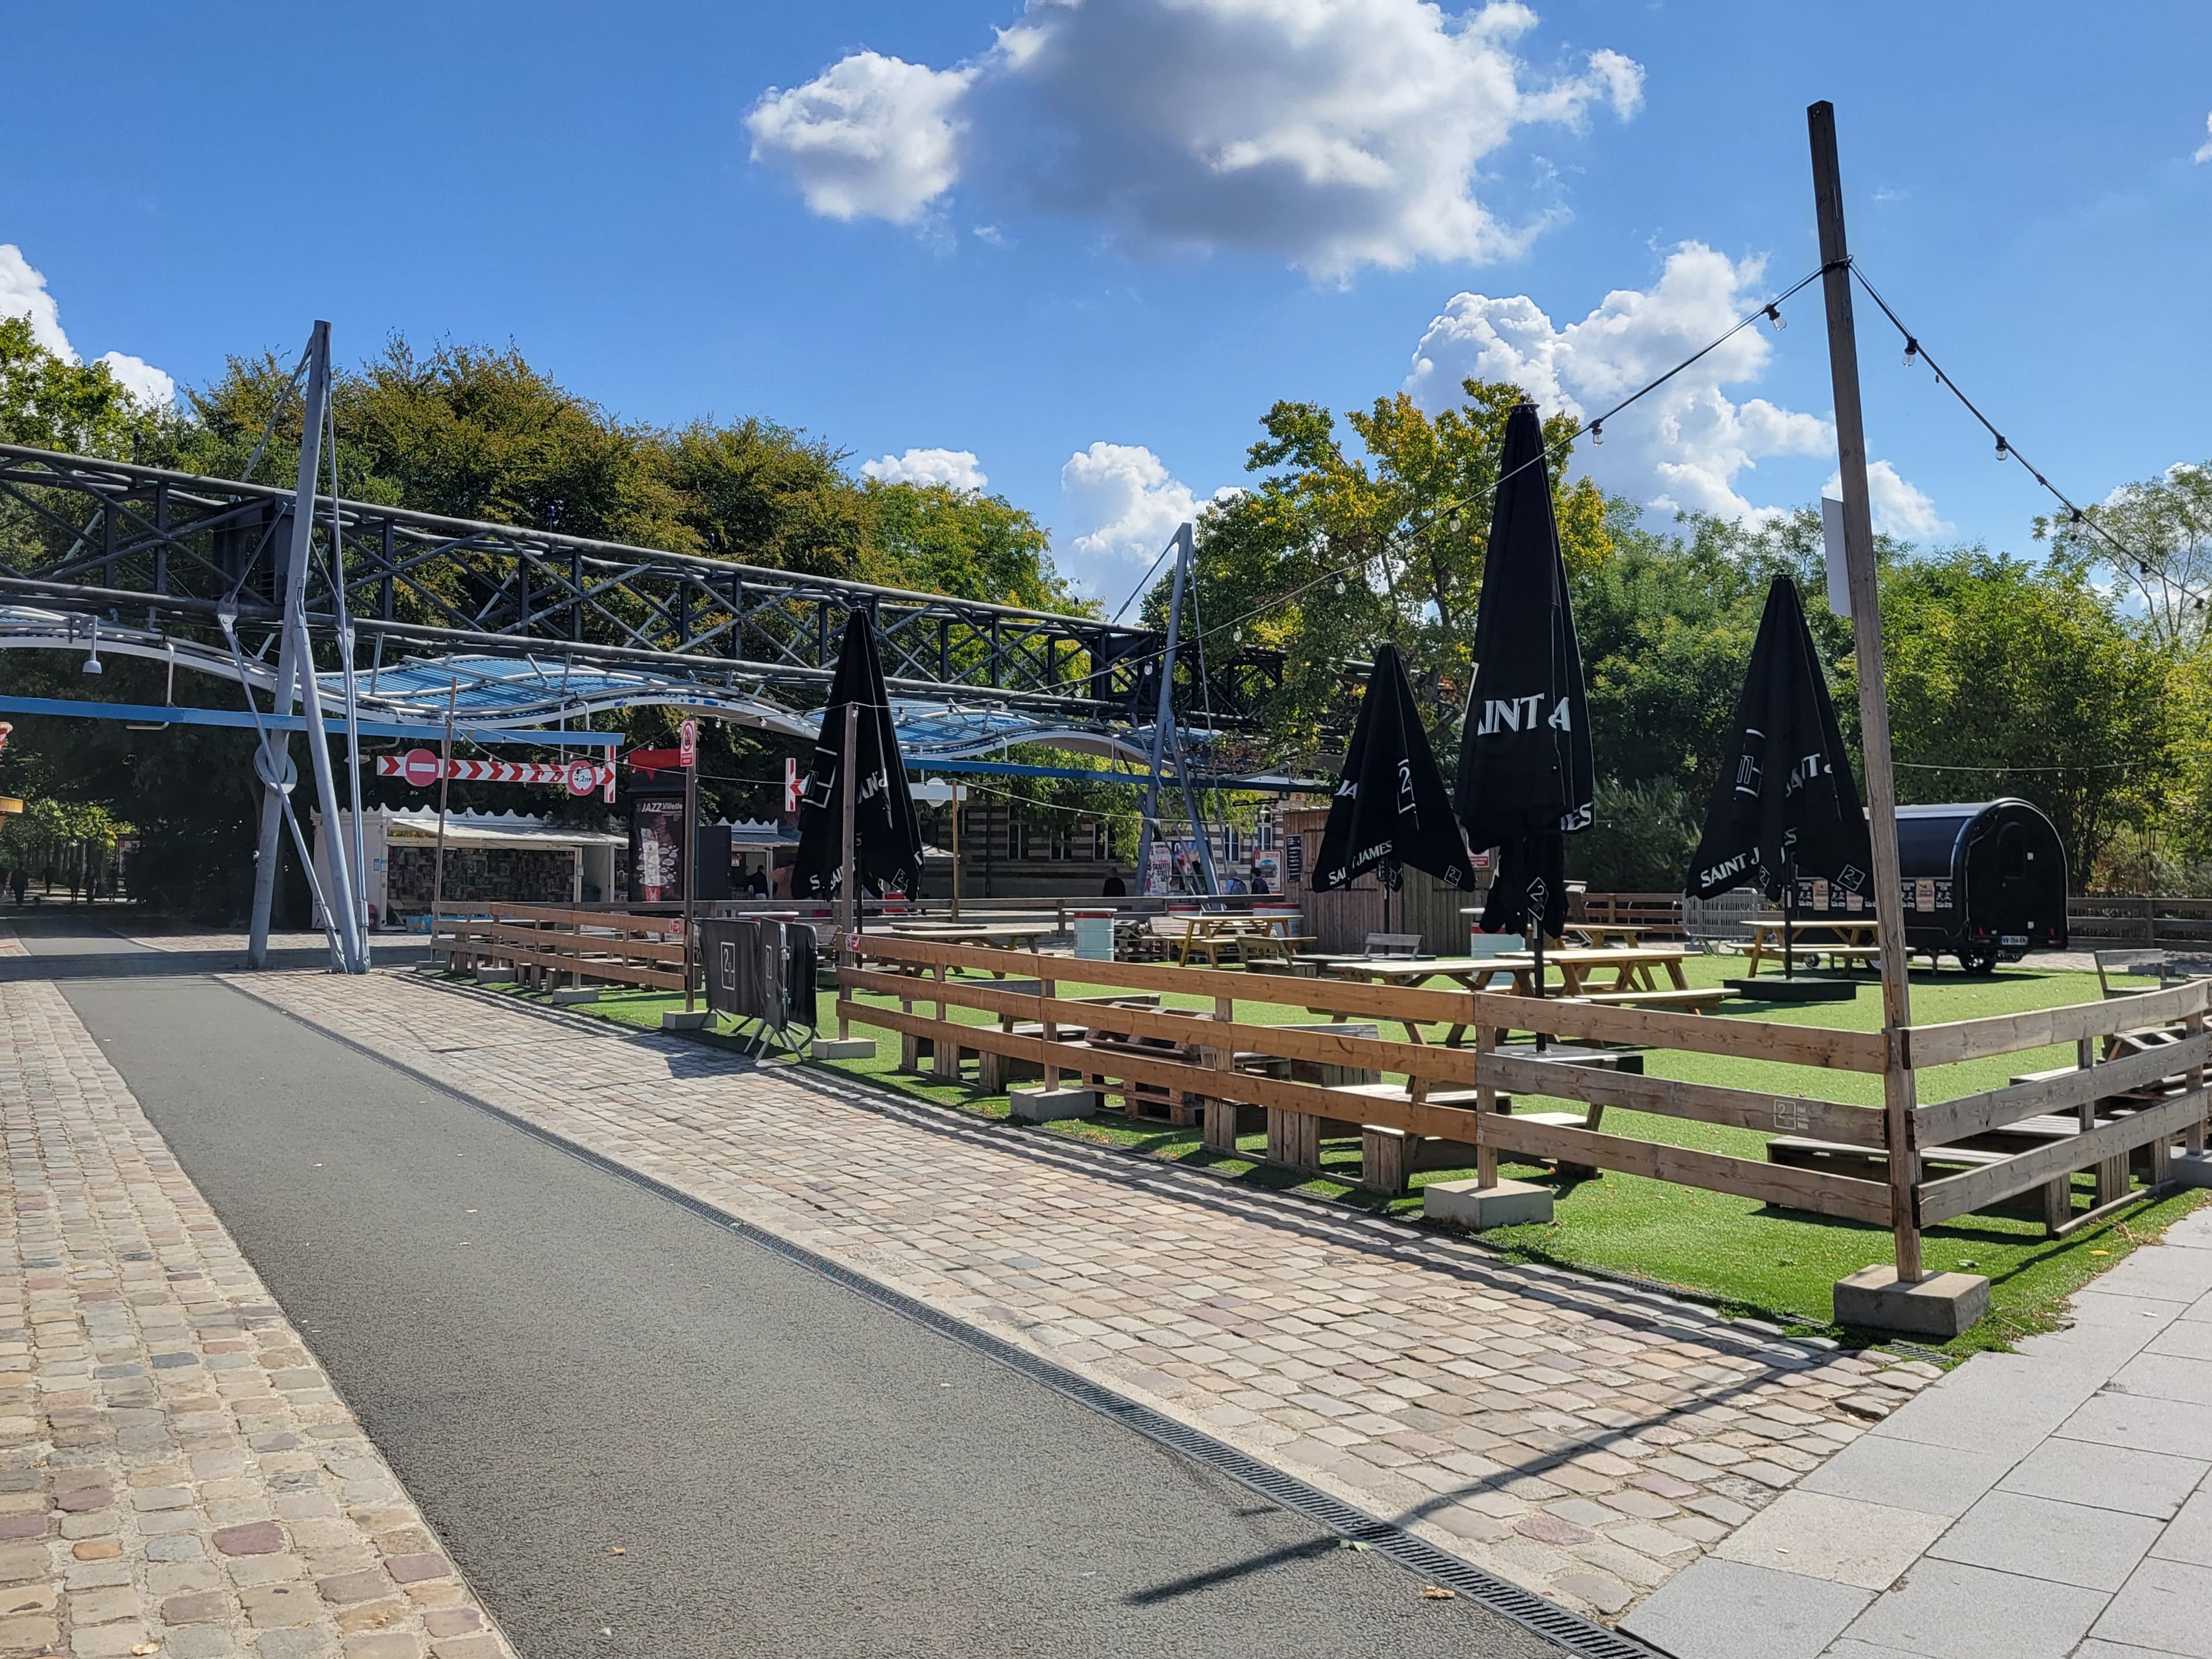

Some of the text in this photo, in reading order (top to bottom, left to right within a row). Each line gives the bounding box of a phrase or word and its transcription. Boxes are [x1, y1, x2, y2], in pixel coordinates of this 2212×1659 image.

[641, 802, 662, 812] JAZZ
[1357, 839, 1392, 866] JAMES
[1700, 853, 1747, 888] SAINT
